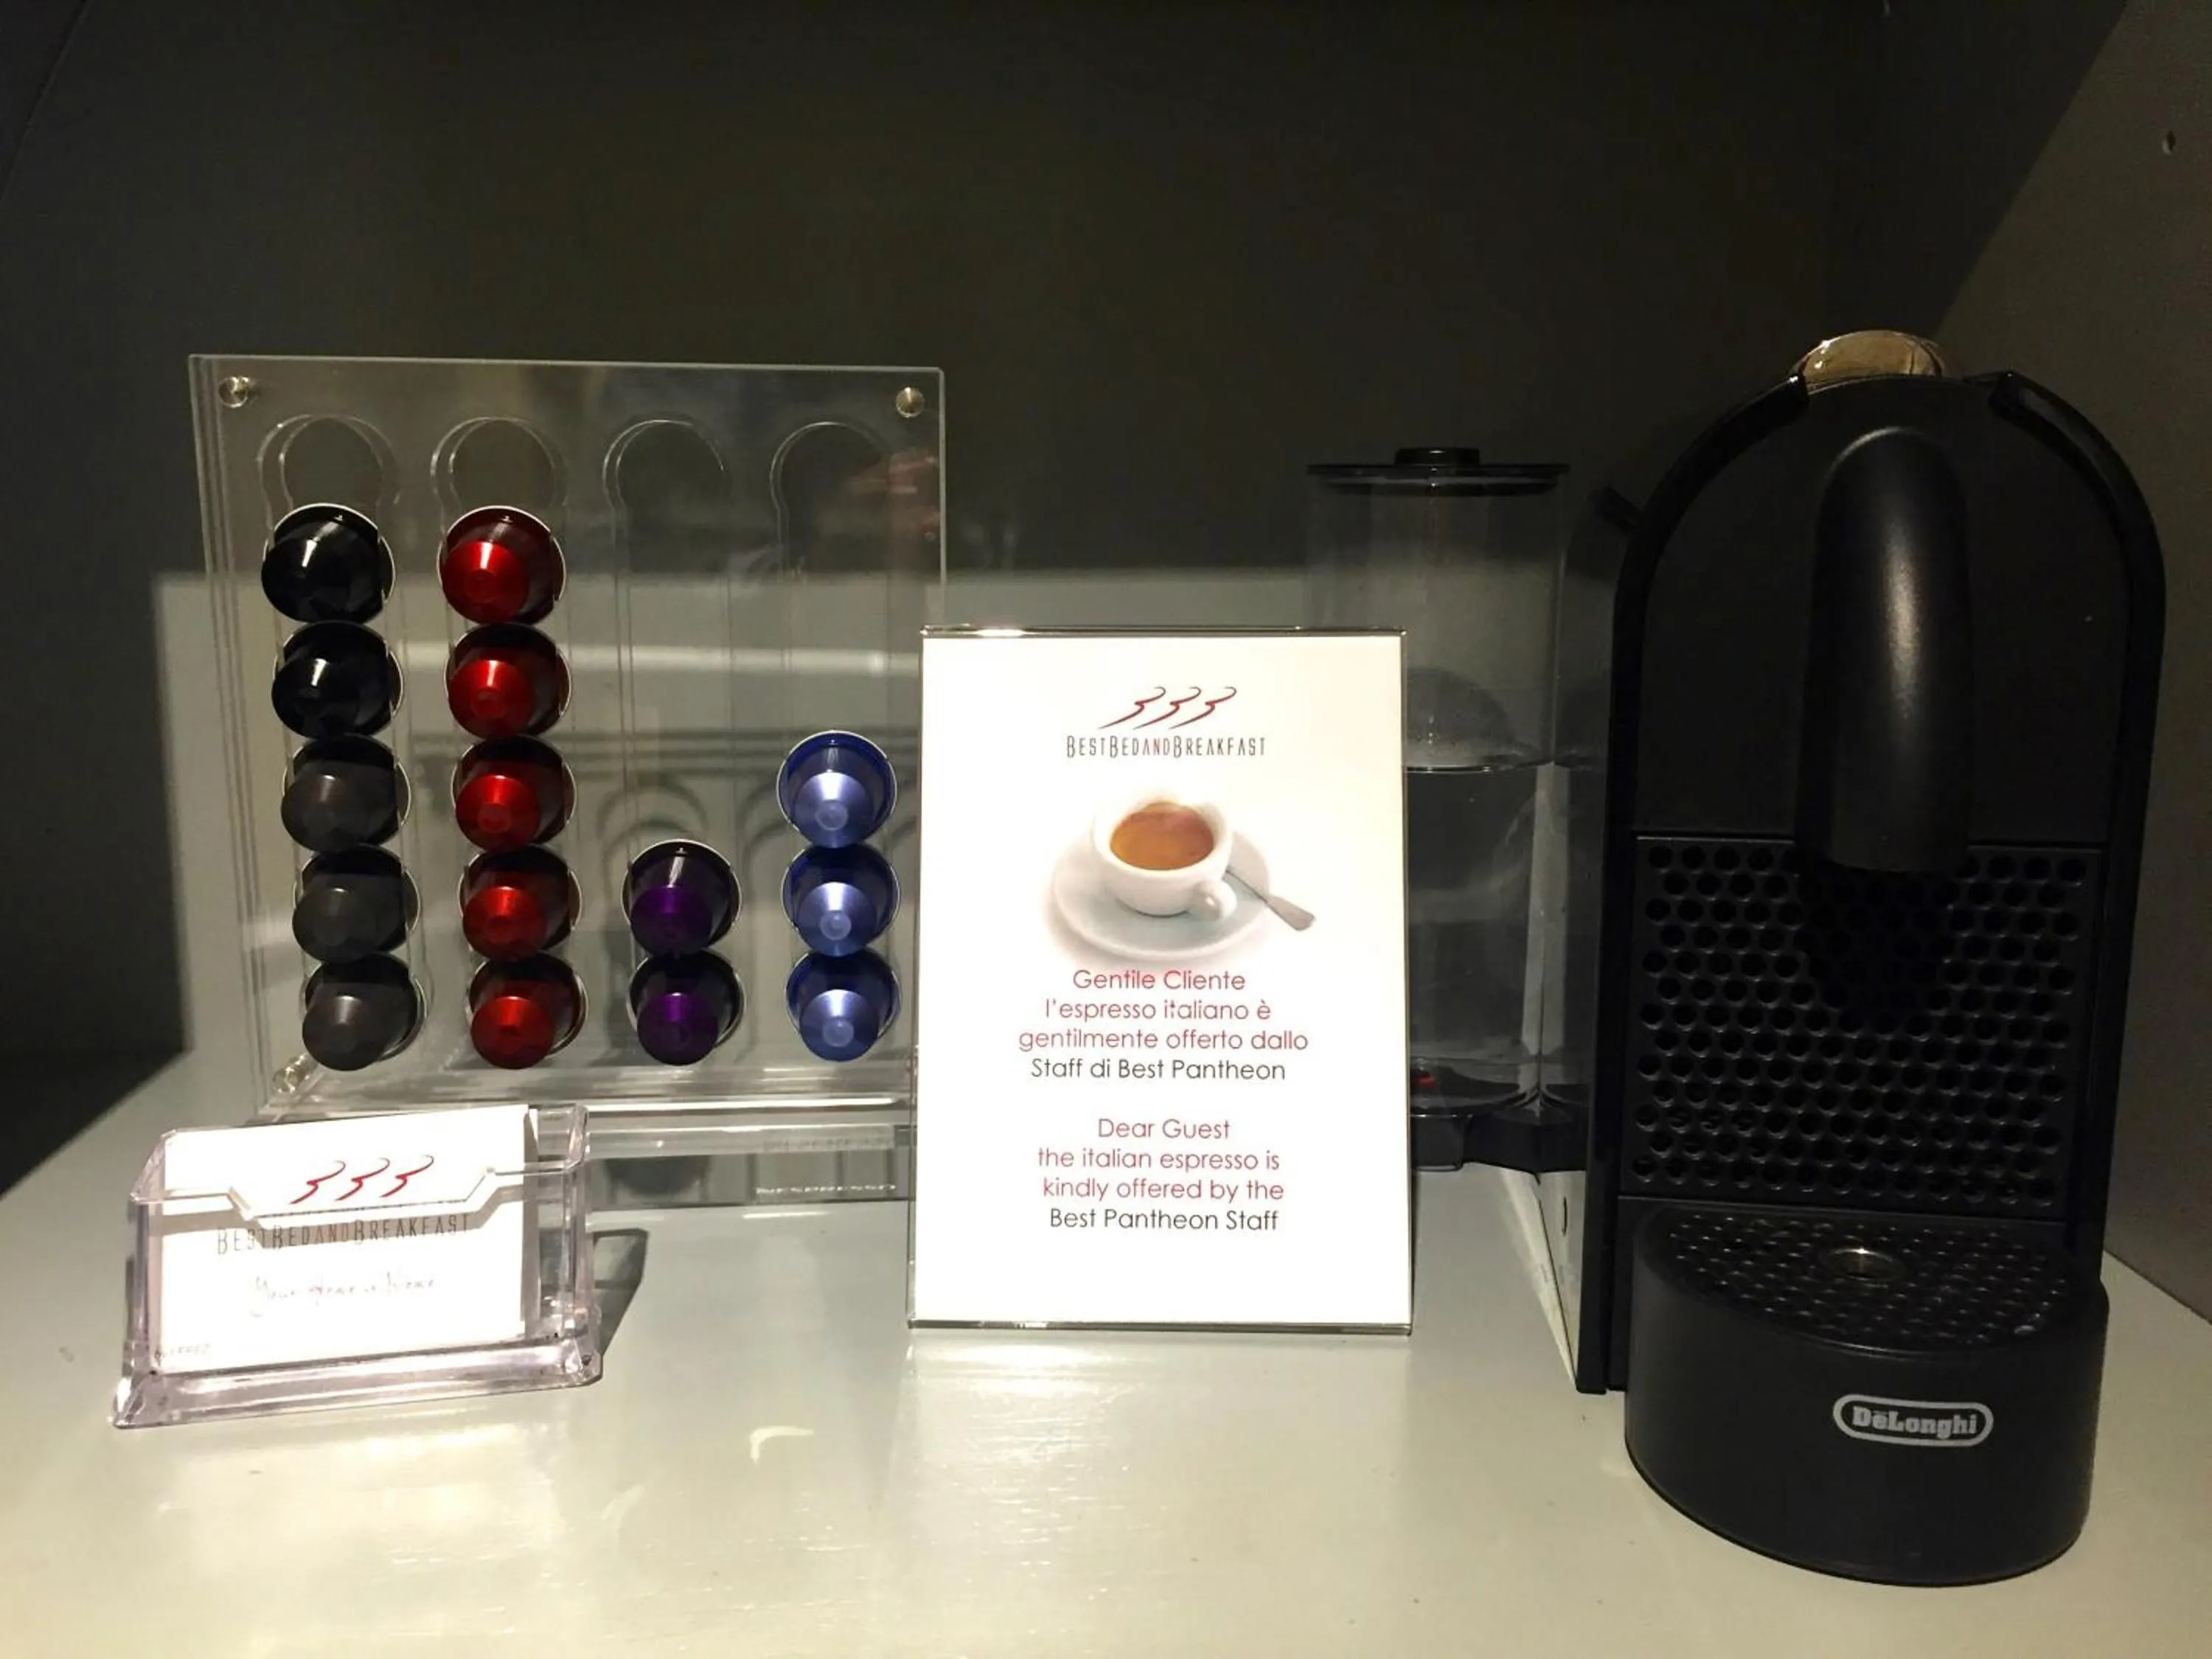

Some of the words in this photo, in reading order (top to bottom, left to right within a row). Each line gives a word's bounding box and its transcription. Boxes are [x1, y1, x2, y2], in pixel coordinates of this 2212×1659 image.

[1074, 970, 1155, 989] Gentile
[1164, 970, 1245, 990] Cliente
[1046, 999, 1156, 1023] l'espresso
[1164, 999, 1249, 1020] italiano
[1256, 999, 1270, 1020] è
[1019, 1028, 1158, 1052] gentilmente
[1166, 1029, 1242, 1049] offerto
[1251, 1031, 1308, 1050] dallo
[1031, 1058, 1082, 1077] Staff
[1090, 1059, 1110, 1078] di
[1119, 1059, 1164, 1079] Best
[1172, 1060, 1285, 1080] Pantheon
[1099, 1119, 1155, 1138] Dear
[1162, 1119, 1230, 1138] Guest
[1038, 1148, 1074, 1167] the
[1083, 1148, 1151, 1168] italian
[1160, 1154, 1259, 1172] espresso
[1267, 1150, 1279, 1170] is
[1044, 1178, 1109, 1201] kindly
[1116, 1178, 1202, 1199] offered
[1211, 1180, 1239, 1203] by
[1247, 1180, 1284, 1200] the
[1051, 1208, 1096, 1228] Best
[1105, 1208, 1218, 1230] Pantheon
[1226, 1210, 1279, 1231] Staff
